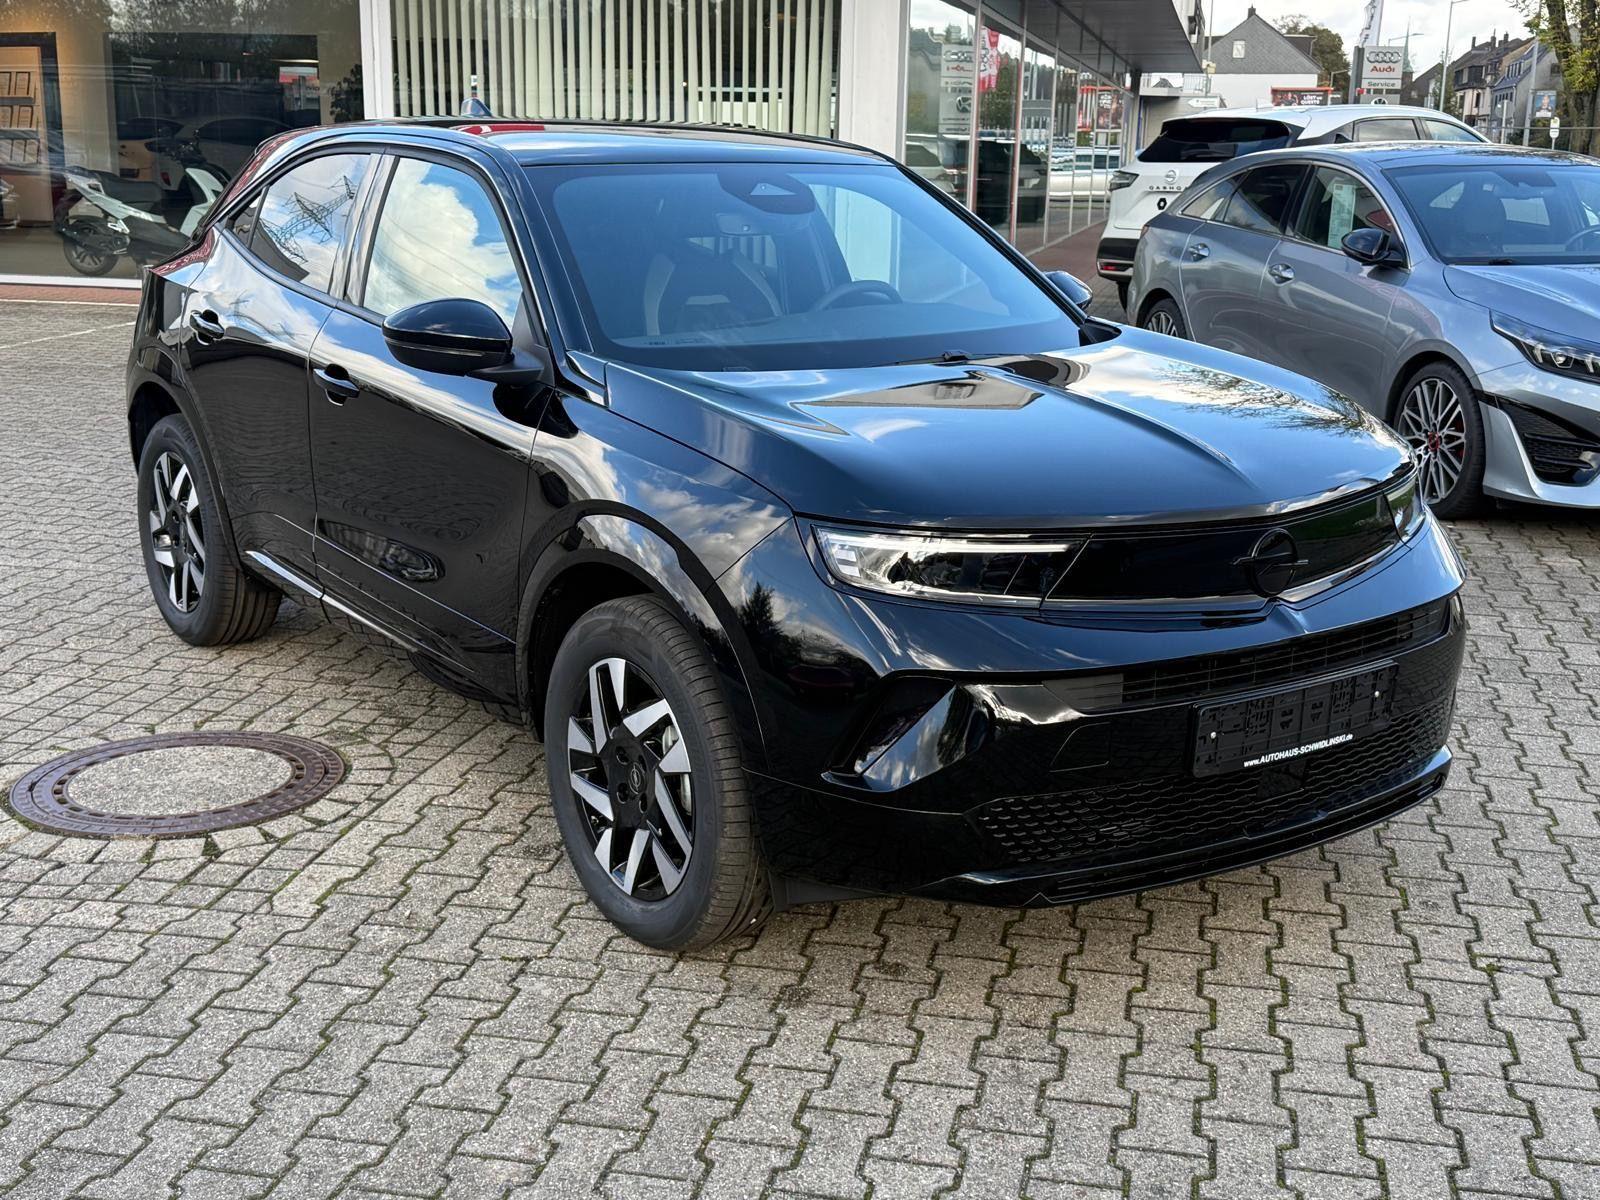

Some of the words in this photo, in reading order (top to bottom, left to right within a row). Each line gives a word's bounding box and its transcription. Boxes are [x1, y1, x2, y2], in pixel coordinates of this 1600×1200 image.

[1370, 65, 1396, 73] Audi
[1367, 80, 1396, 88] Service
[1244, 733, 1354, 768] www.AUTOHAUS-SCHWIDLINSKI.de
